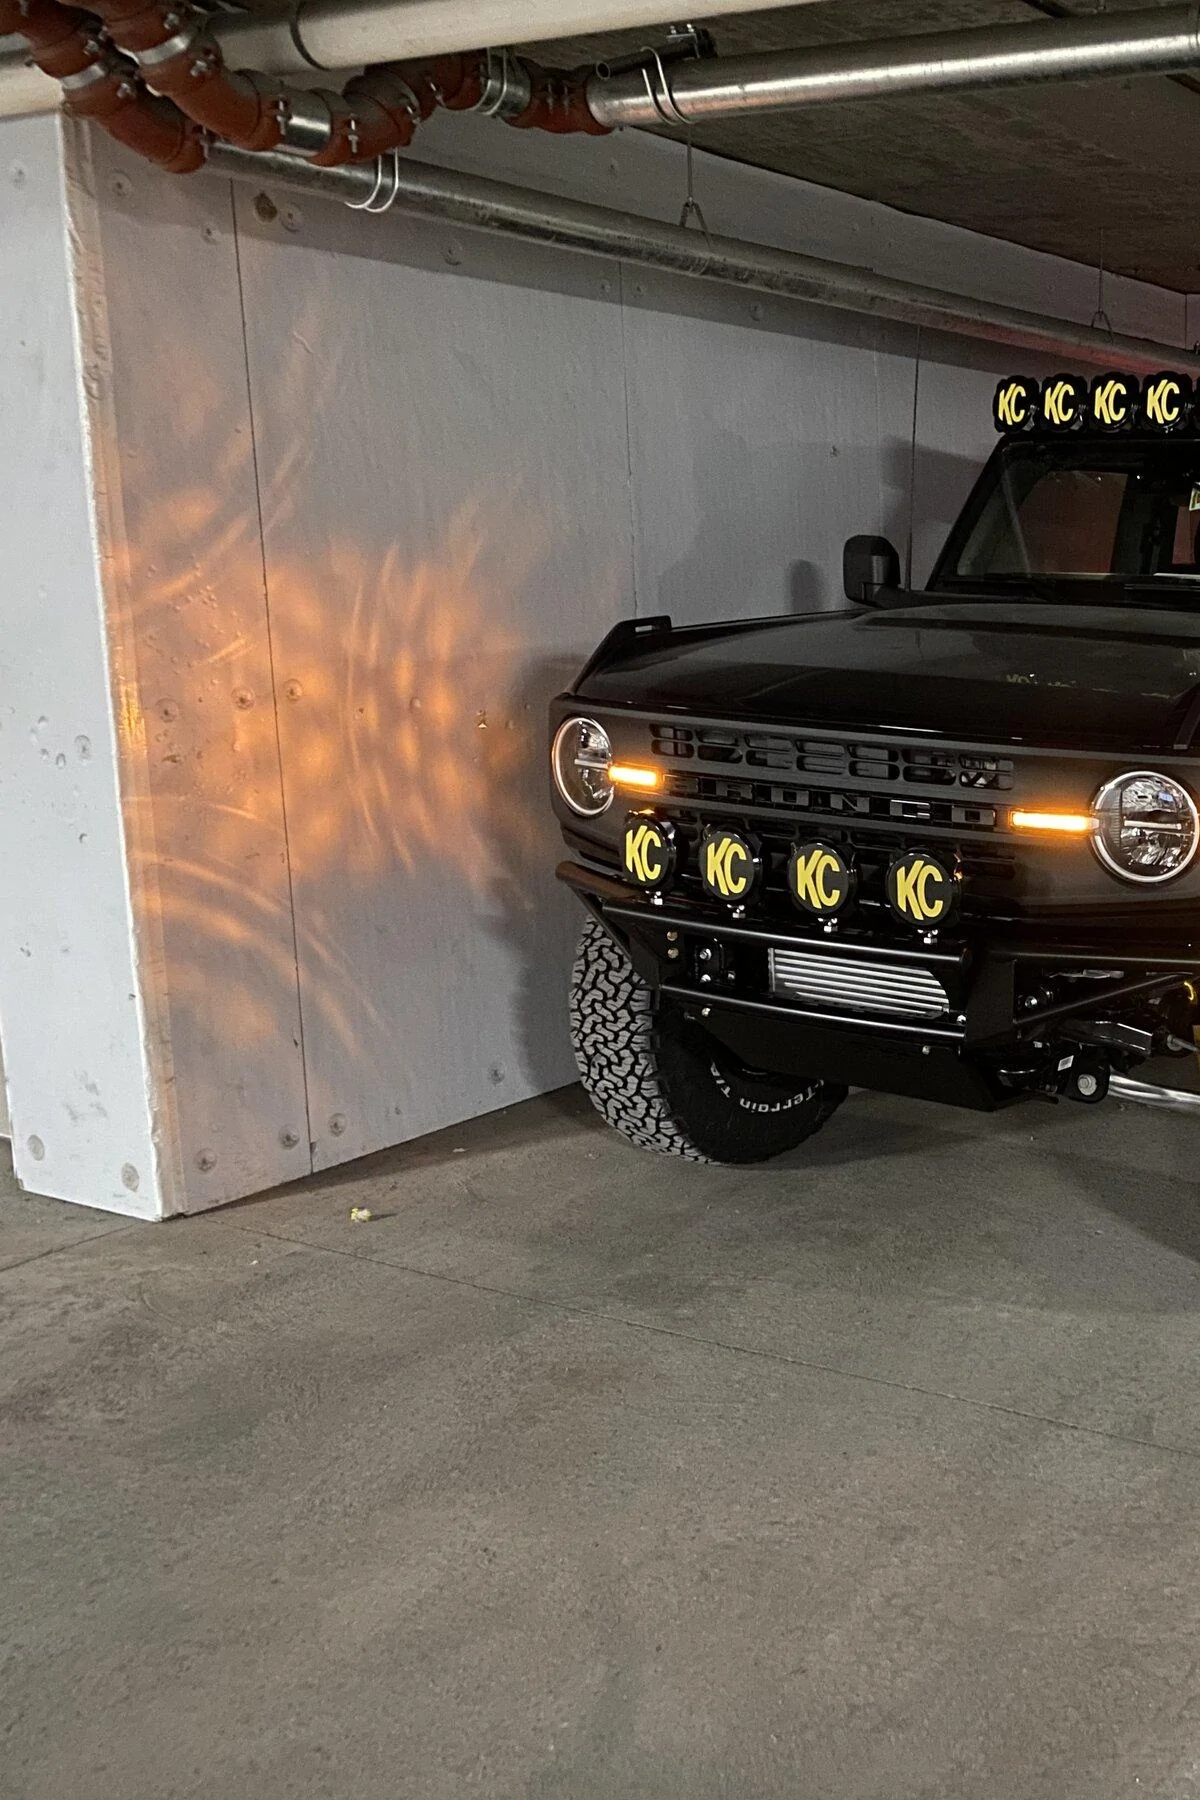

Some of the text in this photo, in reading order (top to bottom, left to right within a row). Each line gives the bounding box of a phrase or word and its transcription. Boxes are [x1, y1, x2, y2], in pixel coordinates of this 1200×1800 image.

[999, 384, 1026, 424] KC
[1044, 382, 1075, 425] KC
[1094, 380, 1127, 425] KC
[1147, 379, 1180, 424] KC
[626, 825, 662, 882] KC
[707, 838, 748, 896] KC
[797, 850, 841, 910] KC
[897, 860, 944, 921] KC
